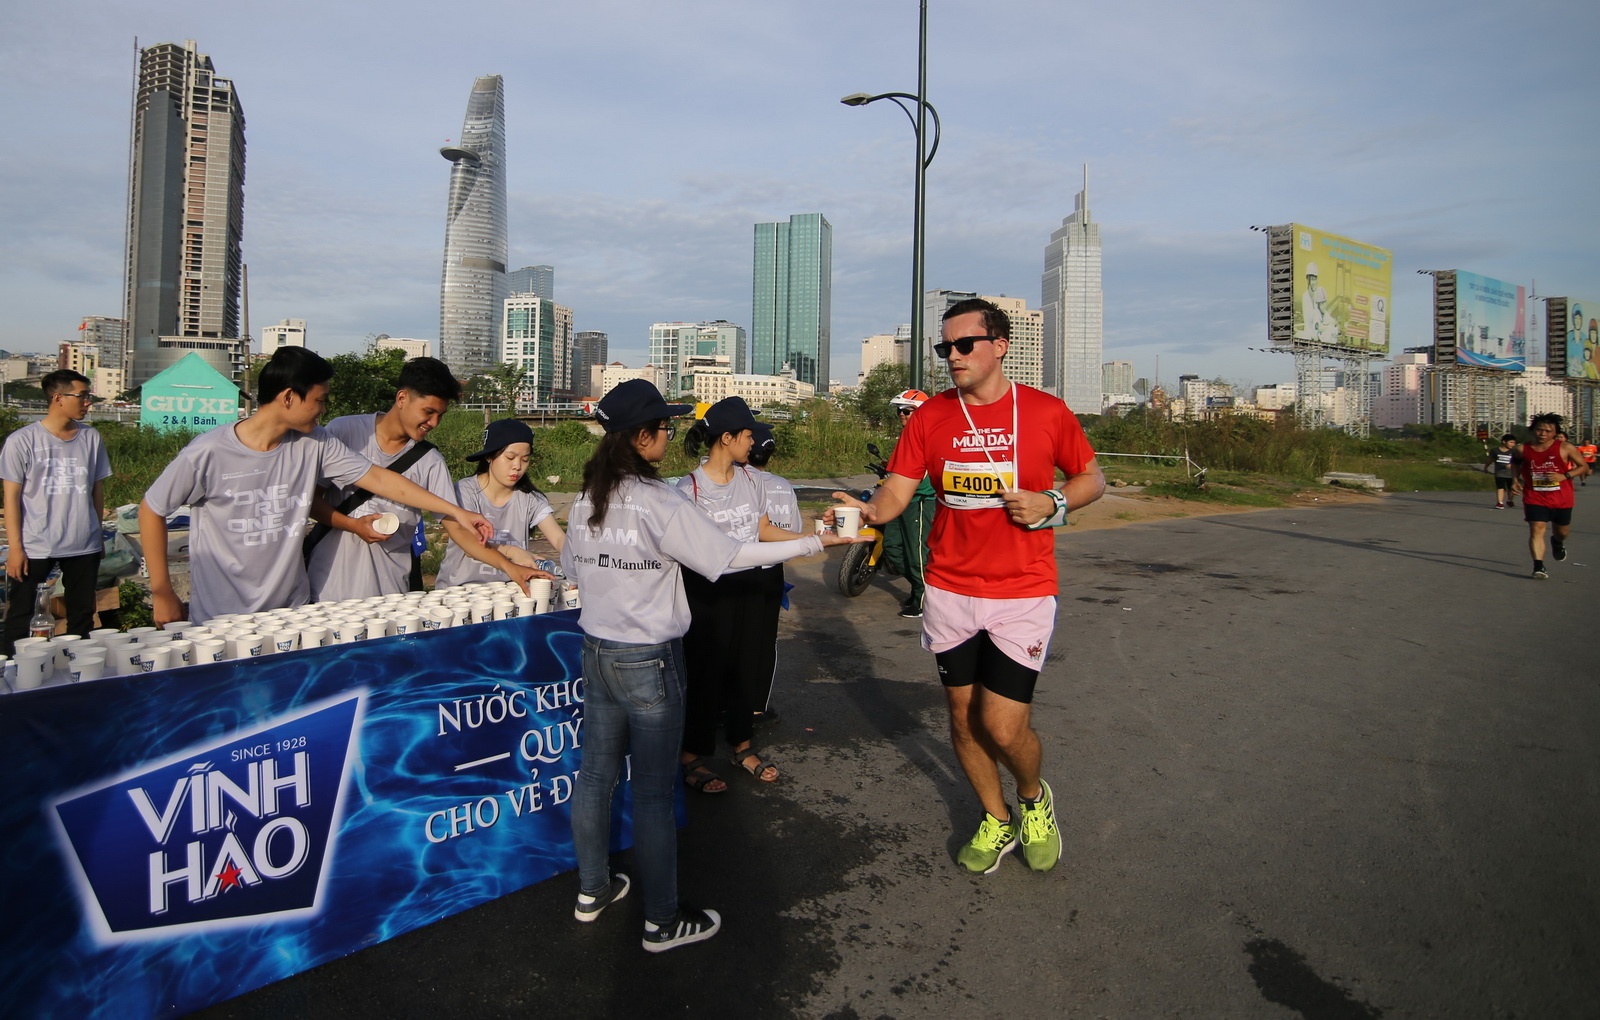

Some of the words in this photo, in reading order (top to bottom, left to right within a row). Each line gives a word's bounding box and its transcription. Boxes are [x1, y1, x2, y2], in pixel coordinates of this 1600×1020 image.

[198, 398, 235, 414] XE
[162, 415, 169, 424] 2
[171, 415, 179, 424] &
[181, 415, 188, 425] 4
[193, 416, 217, 426] Bánh
[953, 435, 985, 448] MUD
[227, 513, 284, 533] ONE
[611, 558, 662, 571] Manulife
[437, 683, 528, 737] NƯỚC
[520, 708, 584, 764] QUÝ
[231, 743, 272, 762] SINCE
[276, 736, 307, 752] 1928
[127, 750, 312, 845] VĨNH
[425, 796, 500, 844] CHO
[505, 768, 544, 819] VẺ
